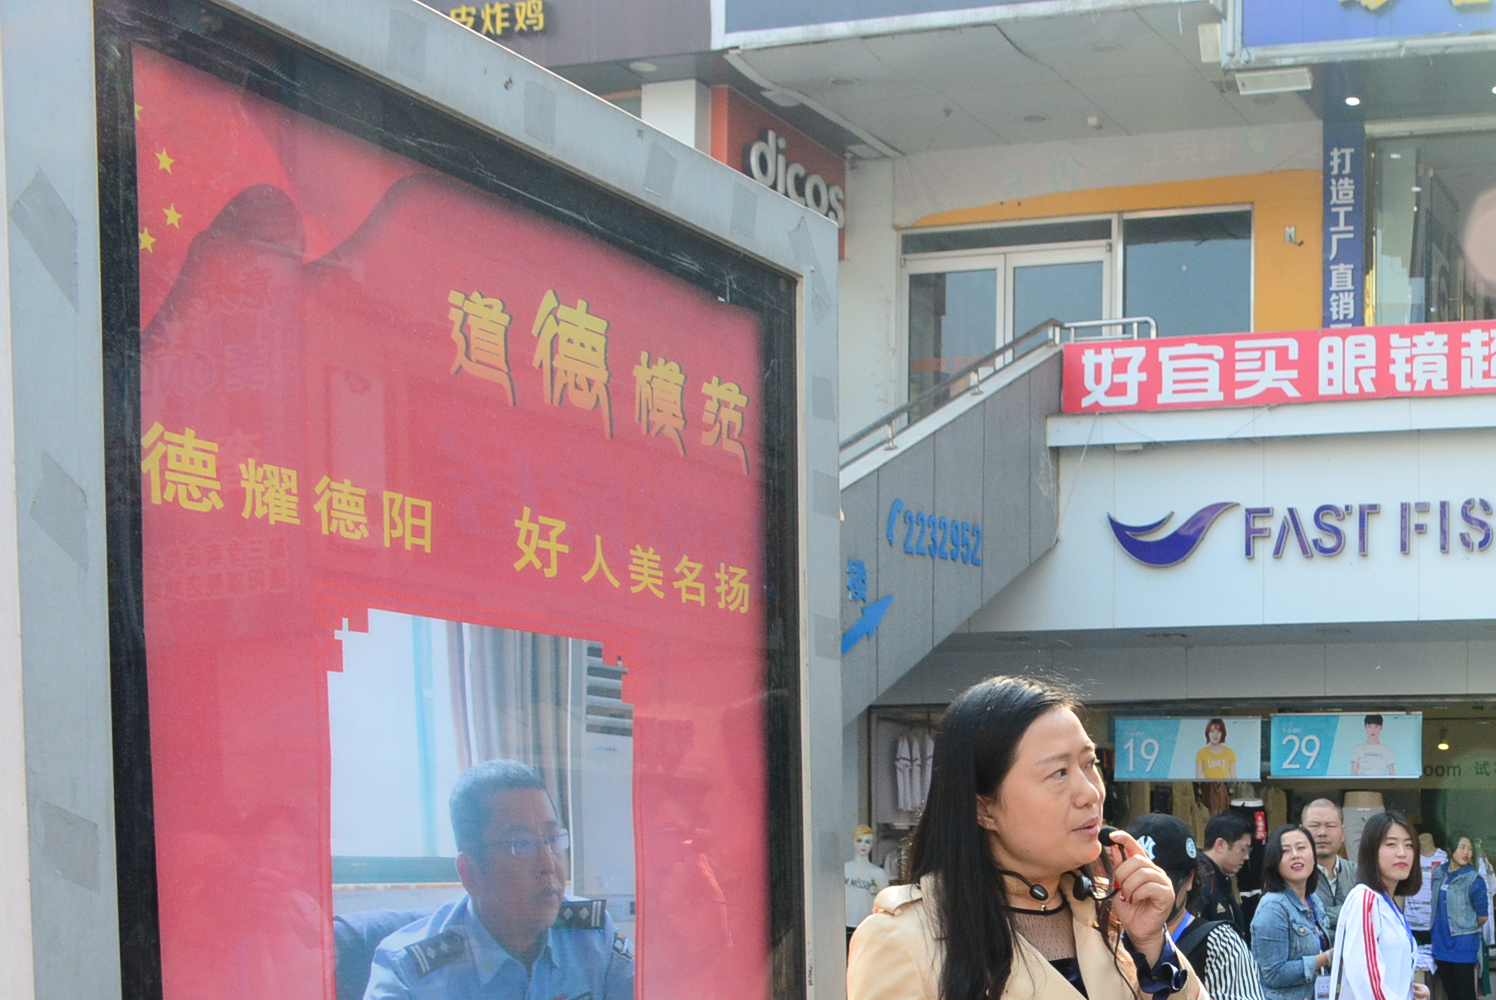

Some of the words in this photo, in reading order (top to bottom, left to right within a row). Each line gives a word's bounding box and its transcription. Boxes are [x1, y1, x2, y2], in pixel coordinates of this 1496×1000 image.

[745, 128, 846, 229] dicos
[1329, 147, 1355, 329] 打造工厂直销
[448, 288, 751, 475] 道德模范
[141, 421, 433, 553] 德耀德阳
[513, 505, 751, 614] 好人美名扬
[903, 509, 983, 566] 2232952
[1244, 502, 1382, 561] FAST
[1123, 738, 1160, 773] 19
[1281, 734, 1321, 770] 29
